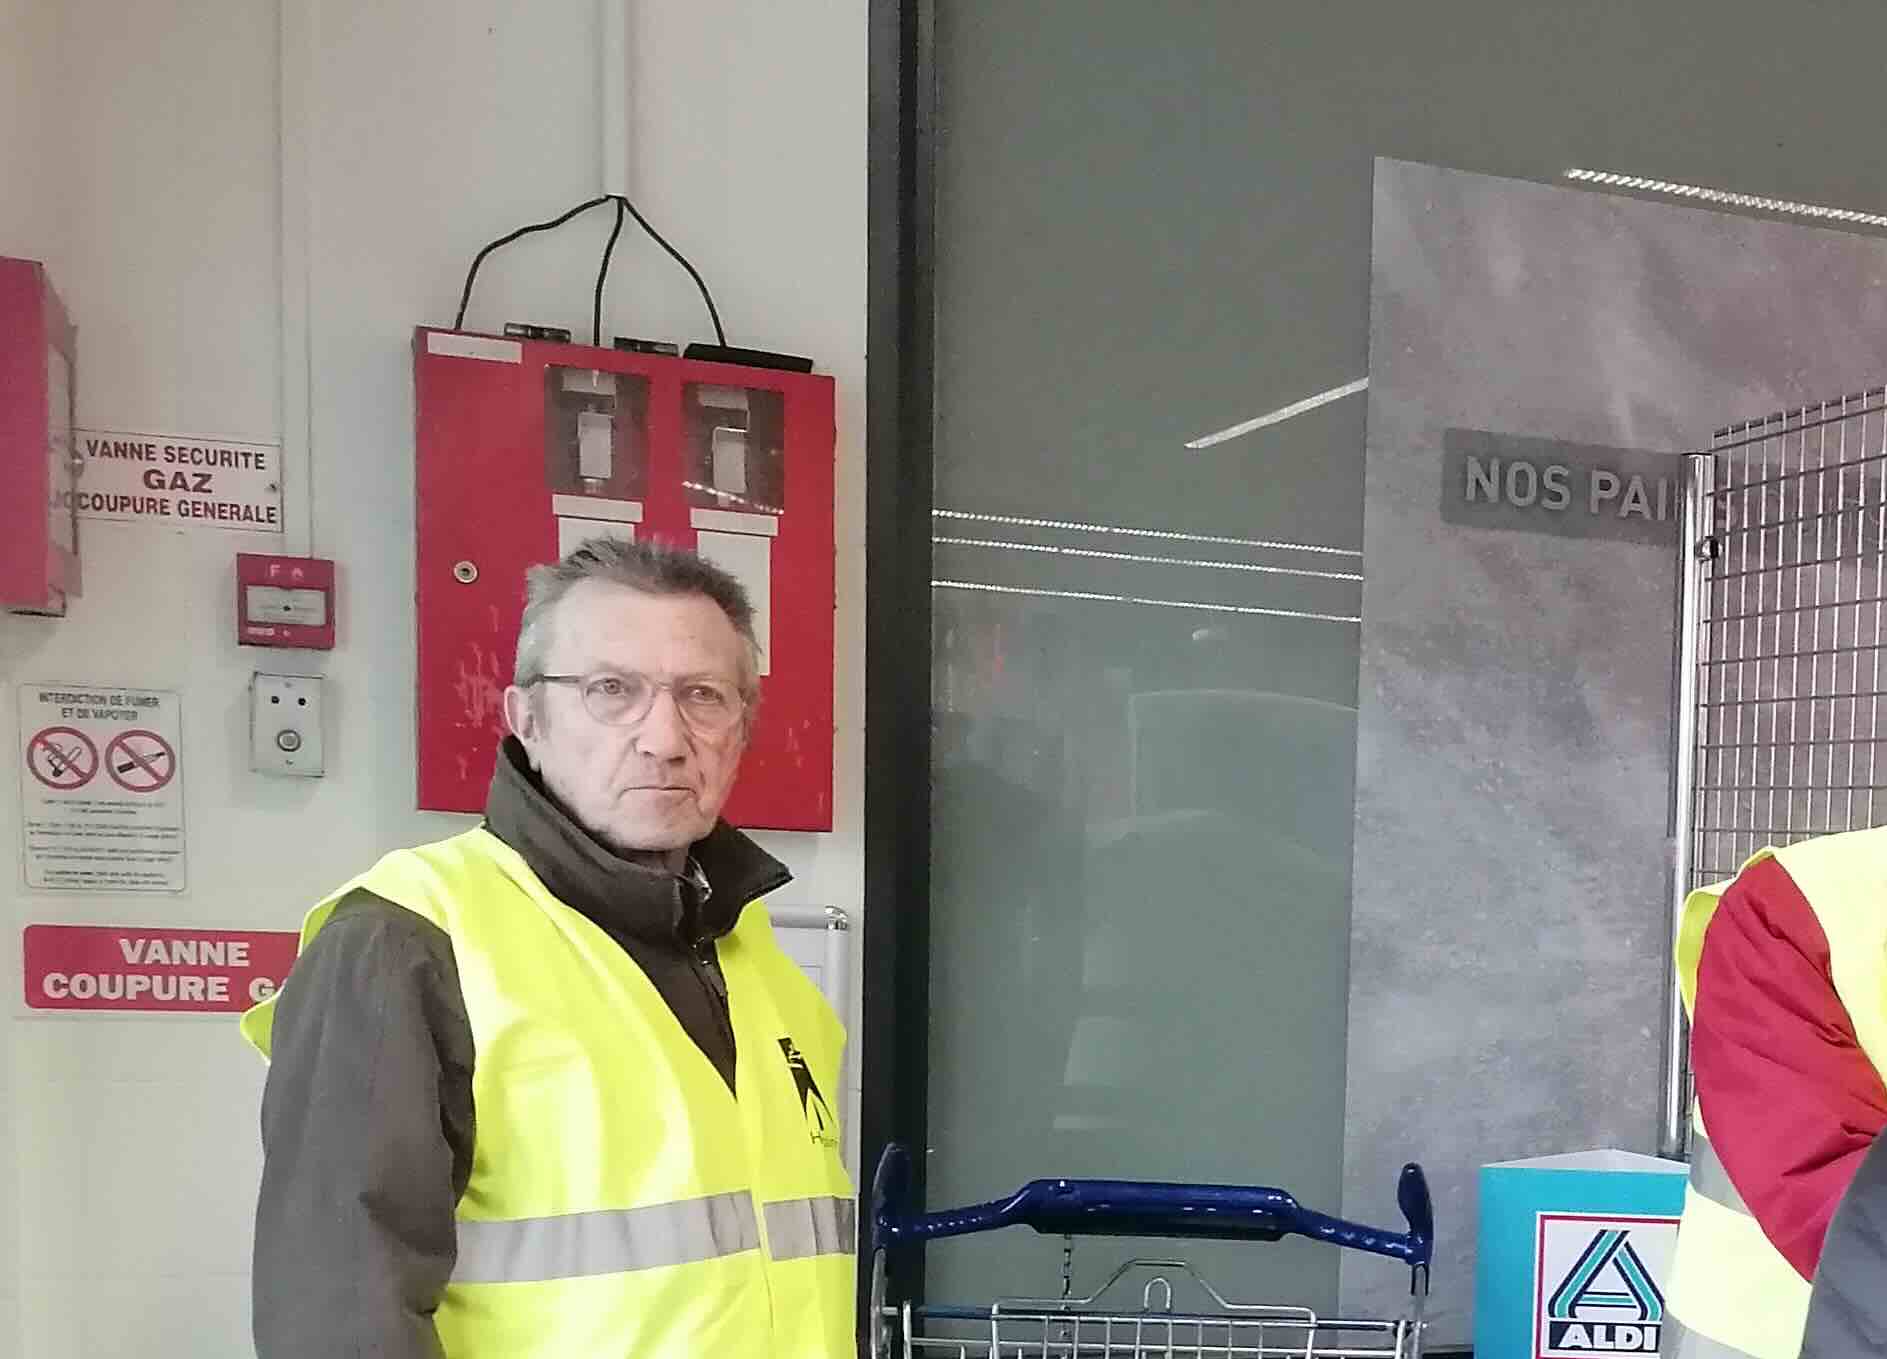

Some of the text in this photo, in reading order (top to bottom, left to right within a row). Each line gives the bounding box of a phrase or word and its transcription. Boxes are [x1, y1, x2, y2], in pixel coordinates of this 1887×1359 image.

[87, 439, 266, 470] VANNE SECURITE
[143, 469, 213, 493] GAZ
[1465, 456, 1571, 511] NOS
[78, 492, 277, 523] COUPURE GENERALE
[40, 693, 107, 705] INTERDICTION
[110, 695, 122, 706] DE
[91, 708, 138, 721] VAPOTER
[118, 938, 250, 967] VANNE
[43, 972, 230, 1002] COUPURE
[1558, 1323, 1657, 1351] ALDI
